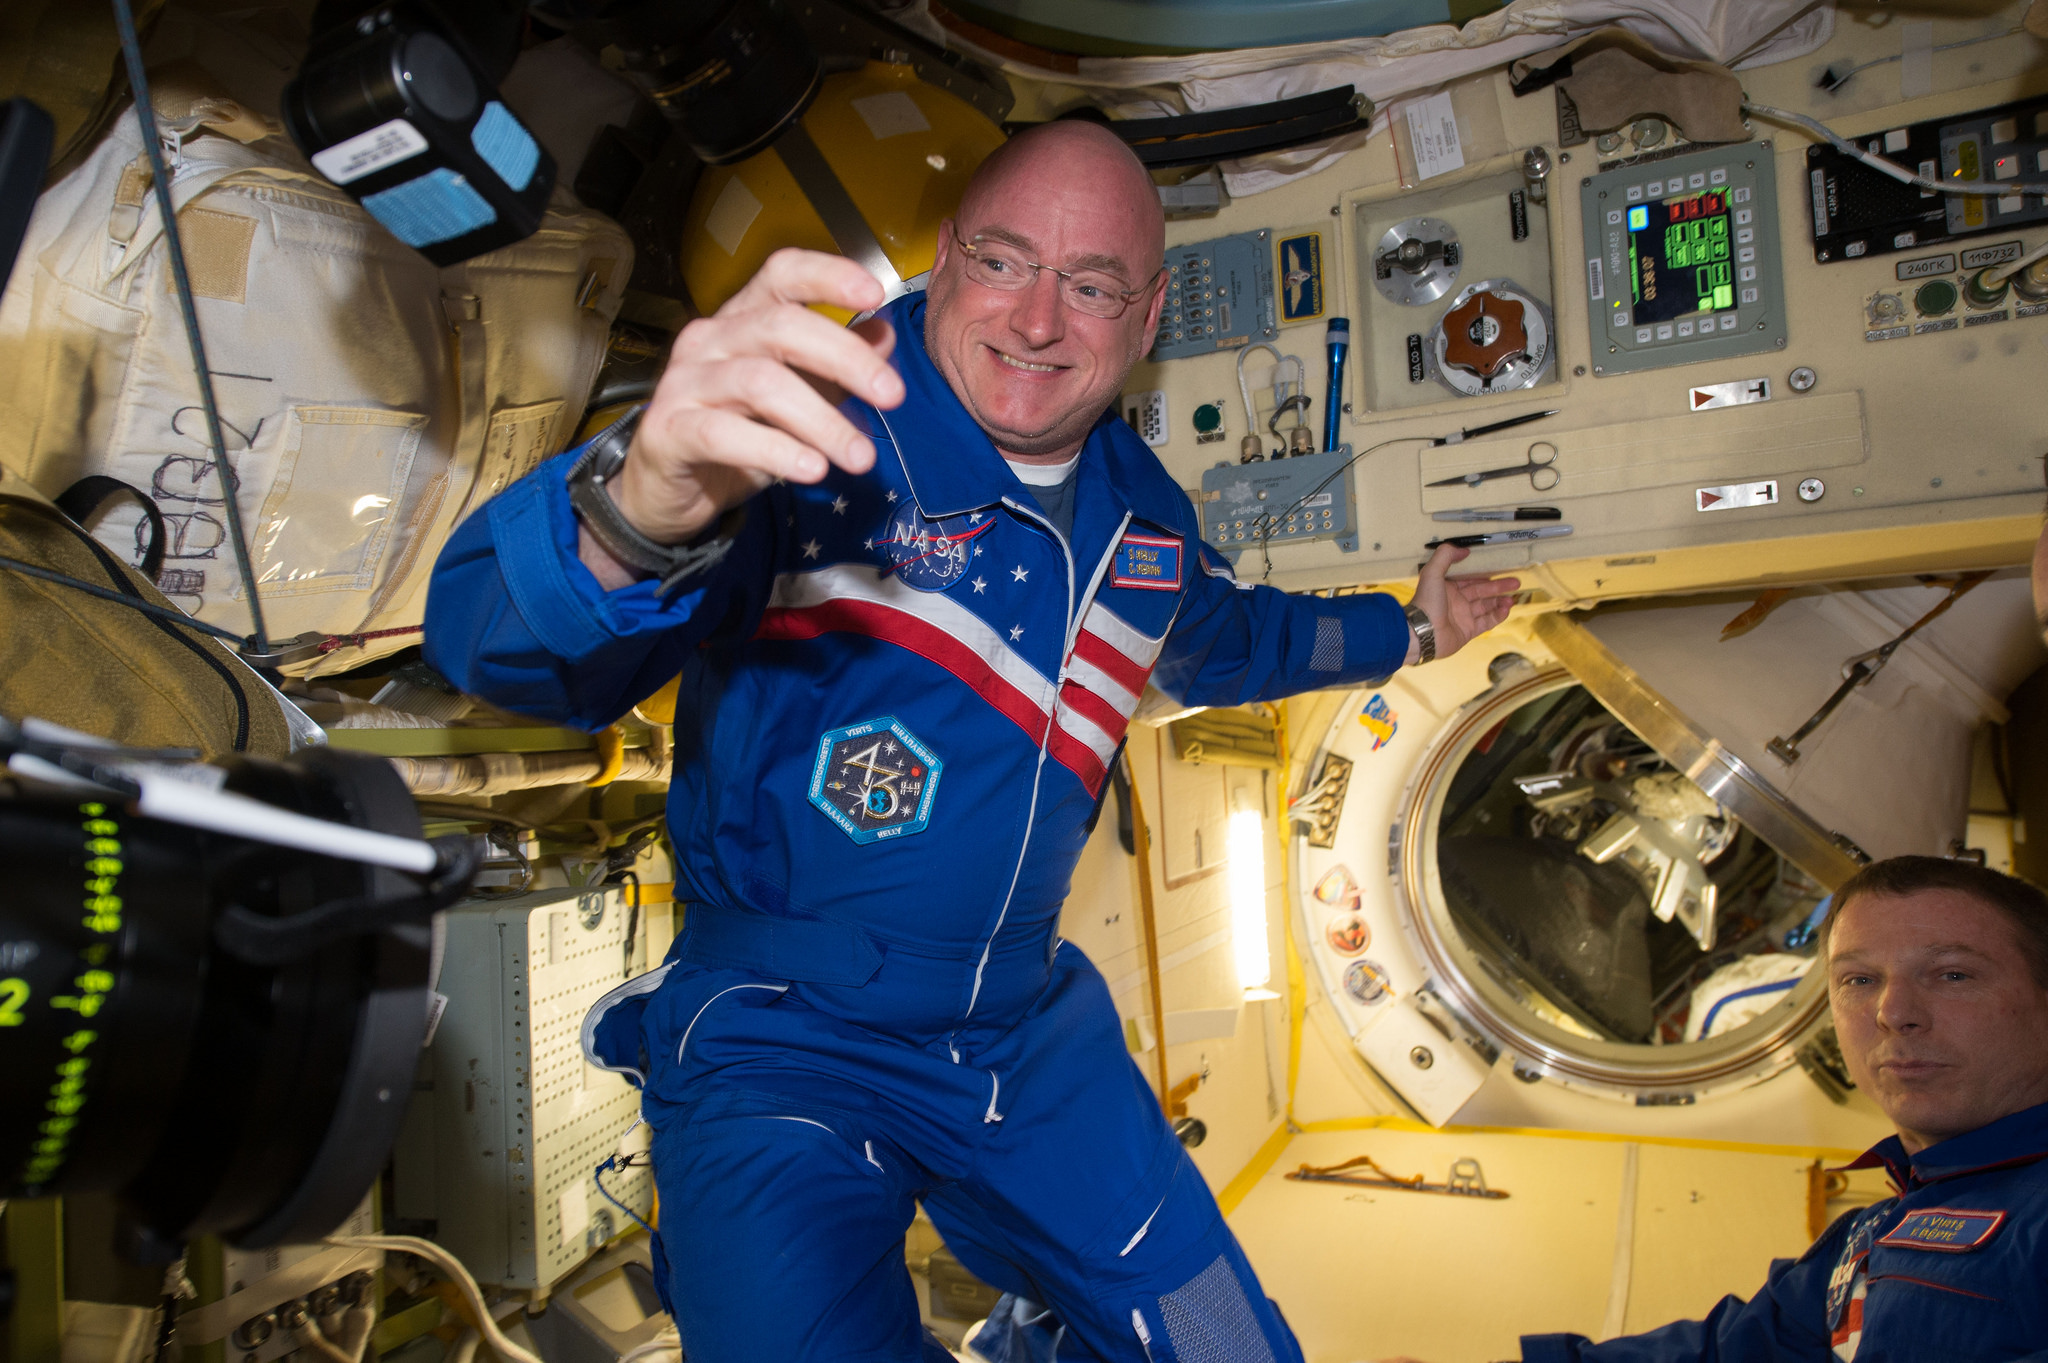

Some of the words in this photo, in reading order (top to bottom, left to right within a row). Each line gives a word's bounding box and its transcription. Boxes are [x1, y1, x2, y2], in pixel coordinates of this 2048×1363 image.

[1968, 248, 2015, 264] 11Ф732
[1907, 260, 1945, 275] 240ГК
[1521, 344, 1545, 379] ЗАКРЫТО
[1466, 384, 1506, 396] ОТКРЫТО
[893, 521, 967, 564] NASA
[845, 724, 873, 737] VIRTS
[891, 723, 936, 767] ШКАПЛЕРОВ
[877, 826, 903, 839] KELLY
